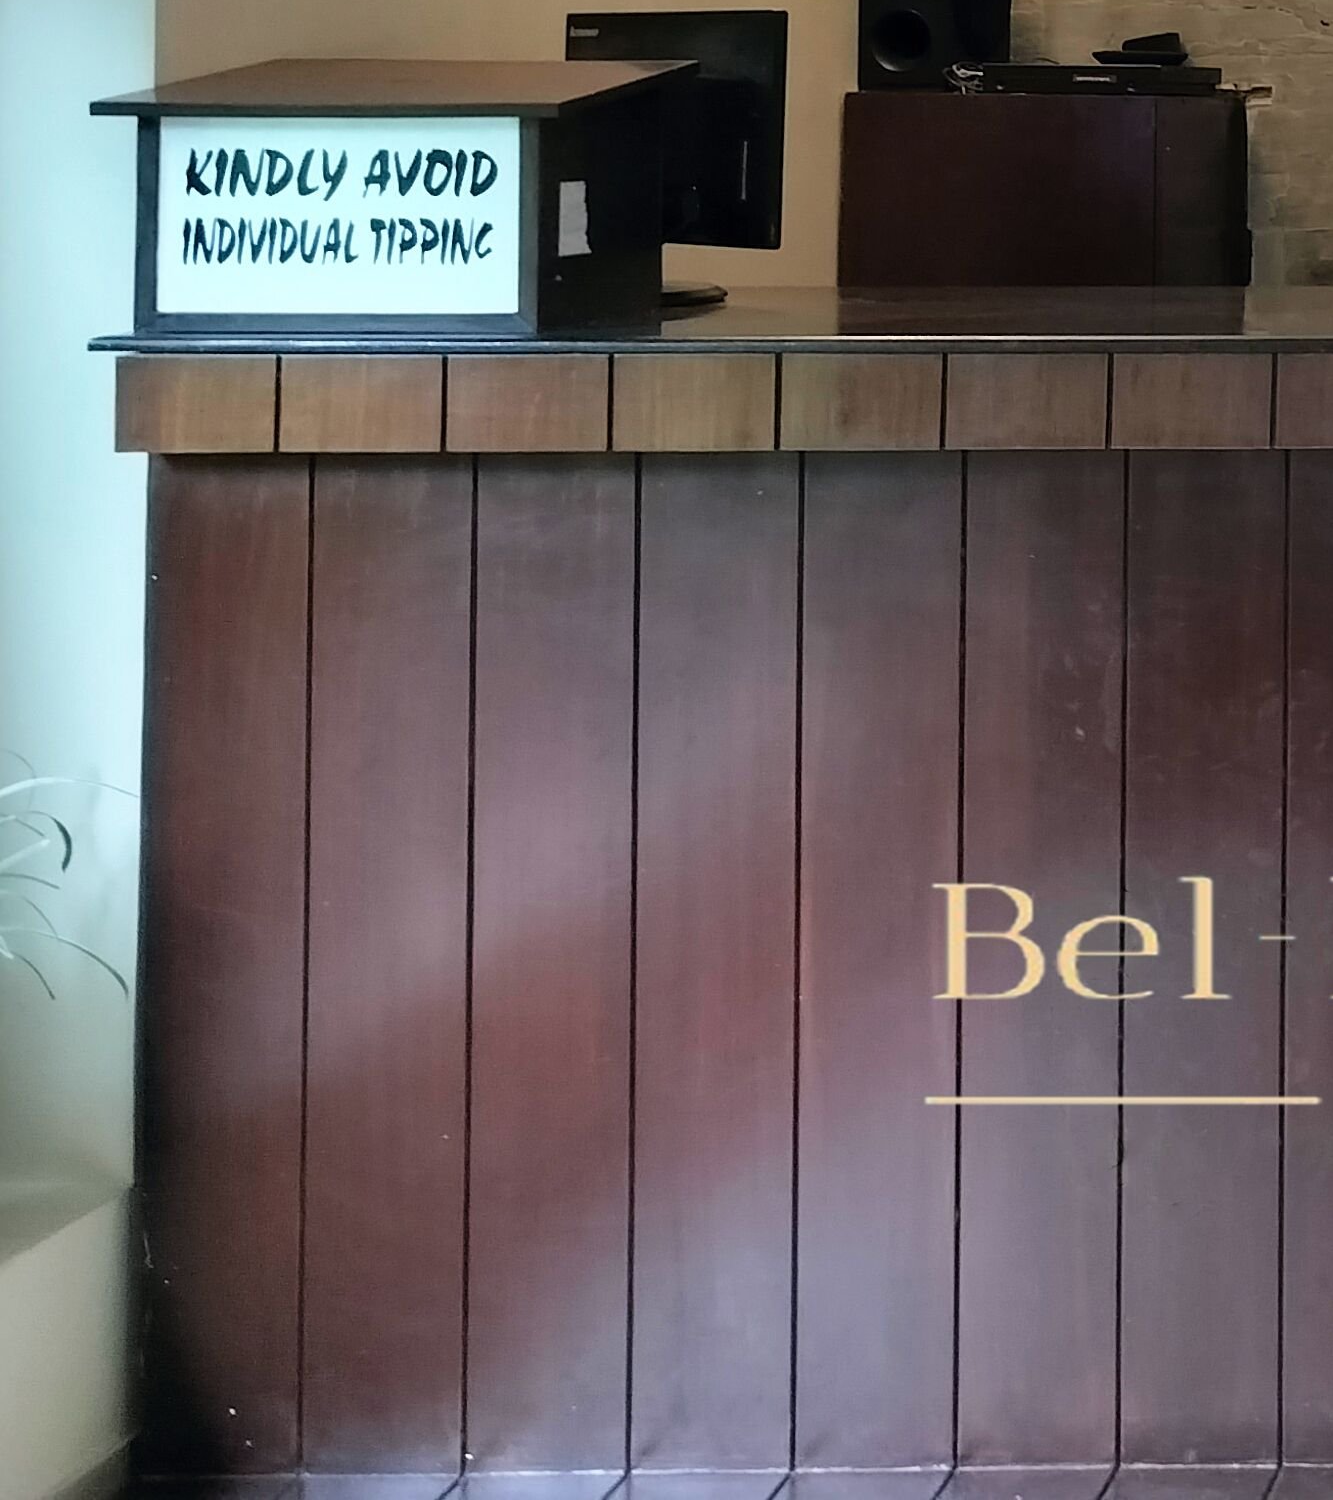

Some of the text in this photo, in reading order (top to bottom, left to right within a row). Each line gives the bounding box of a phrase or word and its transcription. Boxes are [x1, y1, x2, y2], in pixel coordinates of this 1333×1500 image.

[186, 148, 499, 201] KINDLY AVOID
[182, 217, 359, 266] INDIVIDUAL
